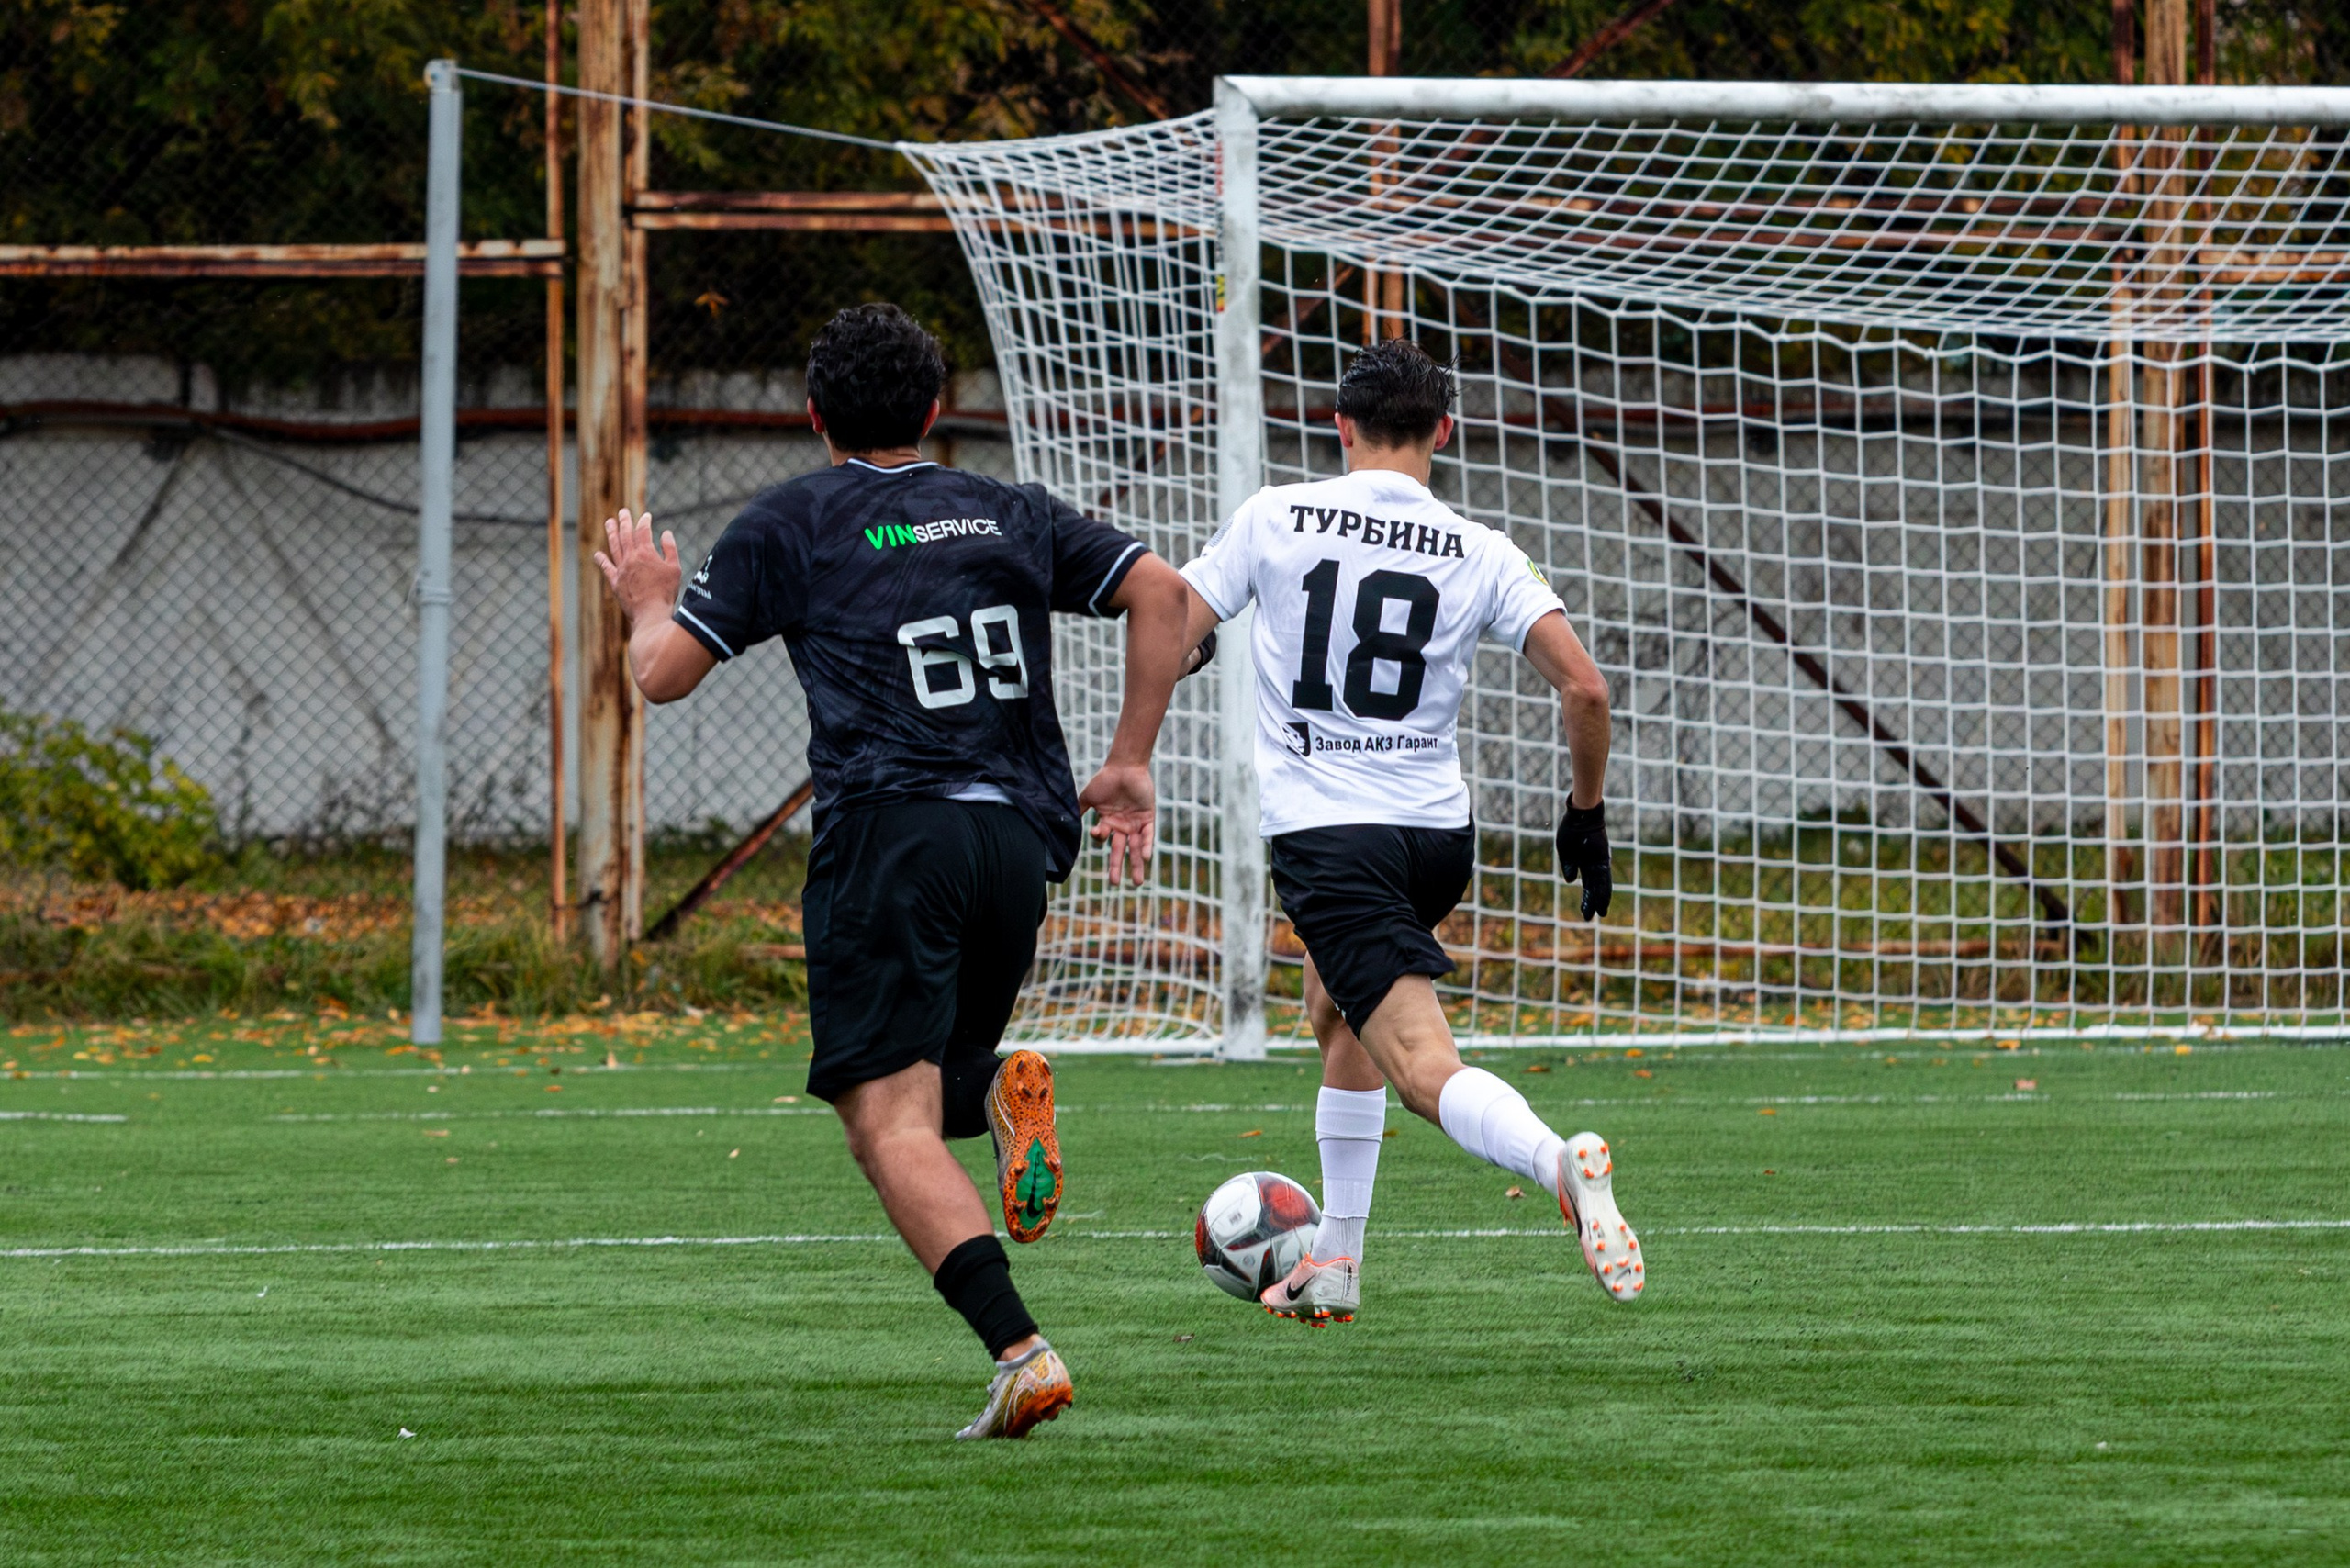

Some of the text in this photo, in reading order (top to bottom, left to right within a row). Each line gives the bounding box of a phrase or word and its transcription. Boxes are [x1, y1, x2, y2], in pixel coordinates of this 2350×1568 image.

[864, 518, 1002, 550] VINSERVICE
[1290, 505, 1464, 558] ТУРБИНА
[897, 604, 1029, 709] 69
[1292, 558, 1440, 721] 18
[1315, 736, 1361, 753] Завод
[1397, 735, 1438, 752] Гарант
